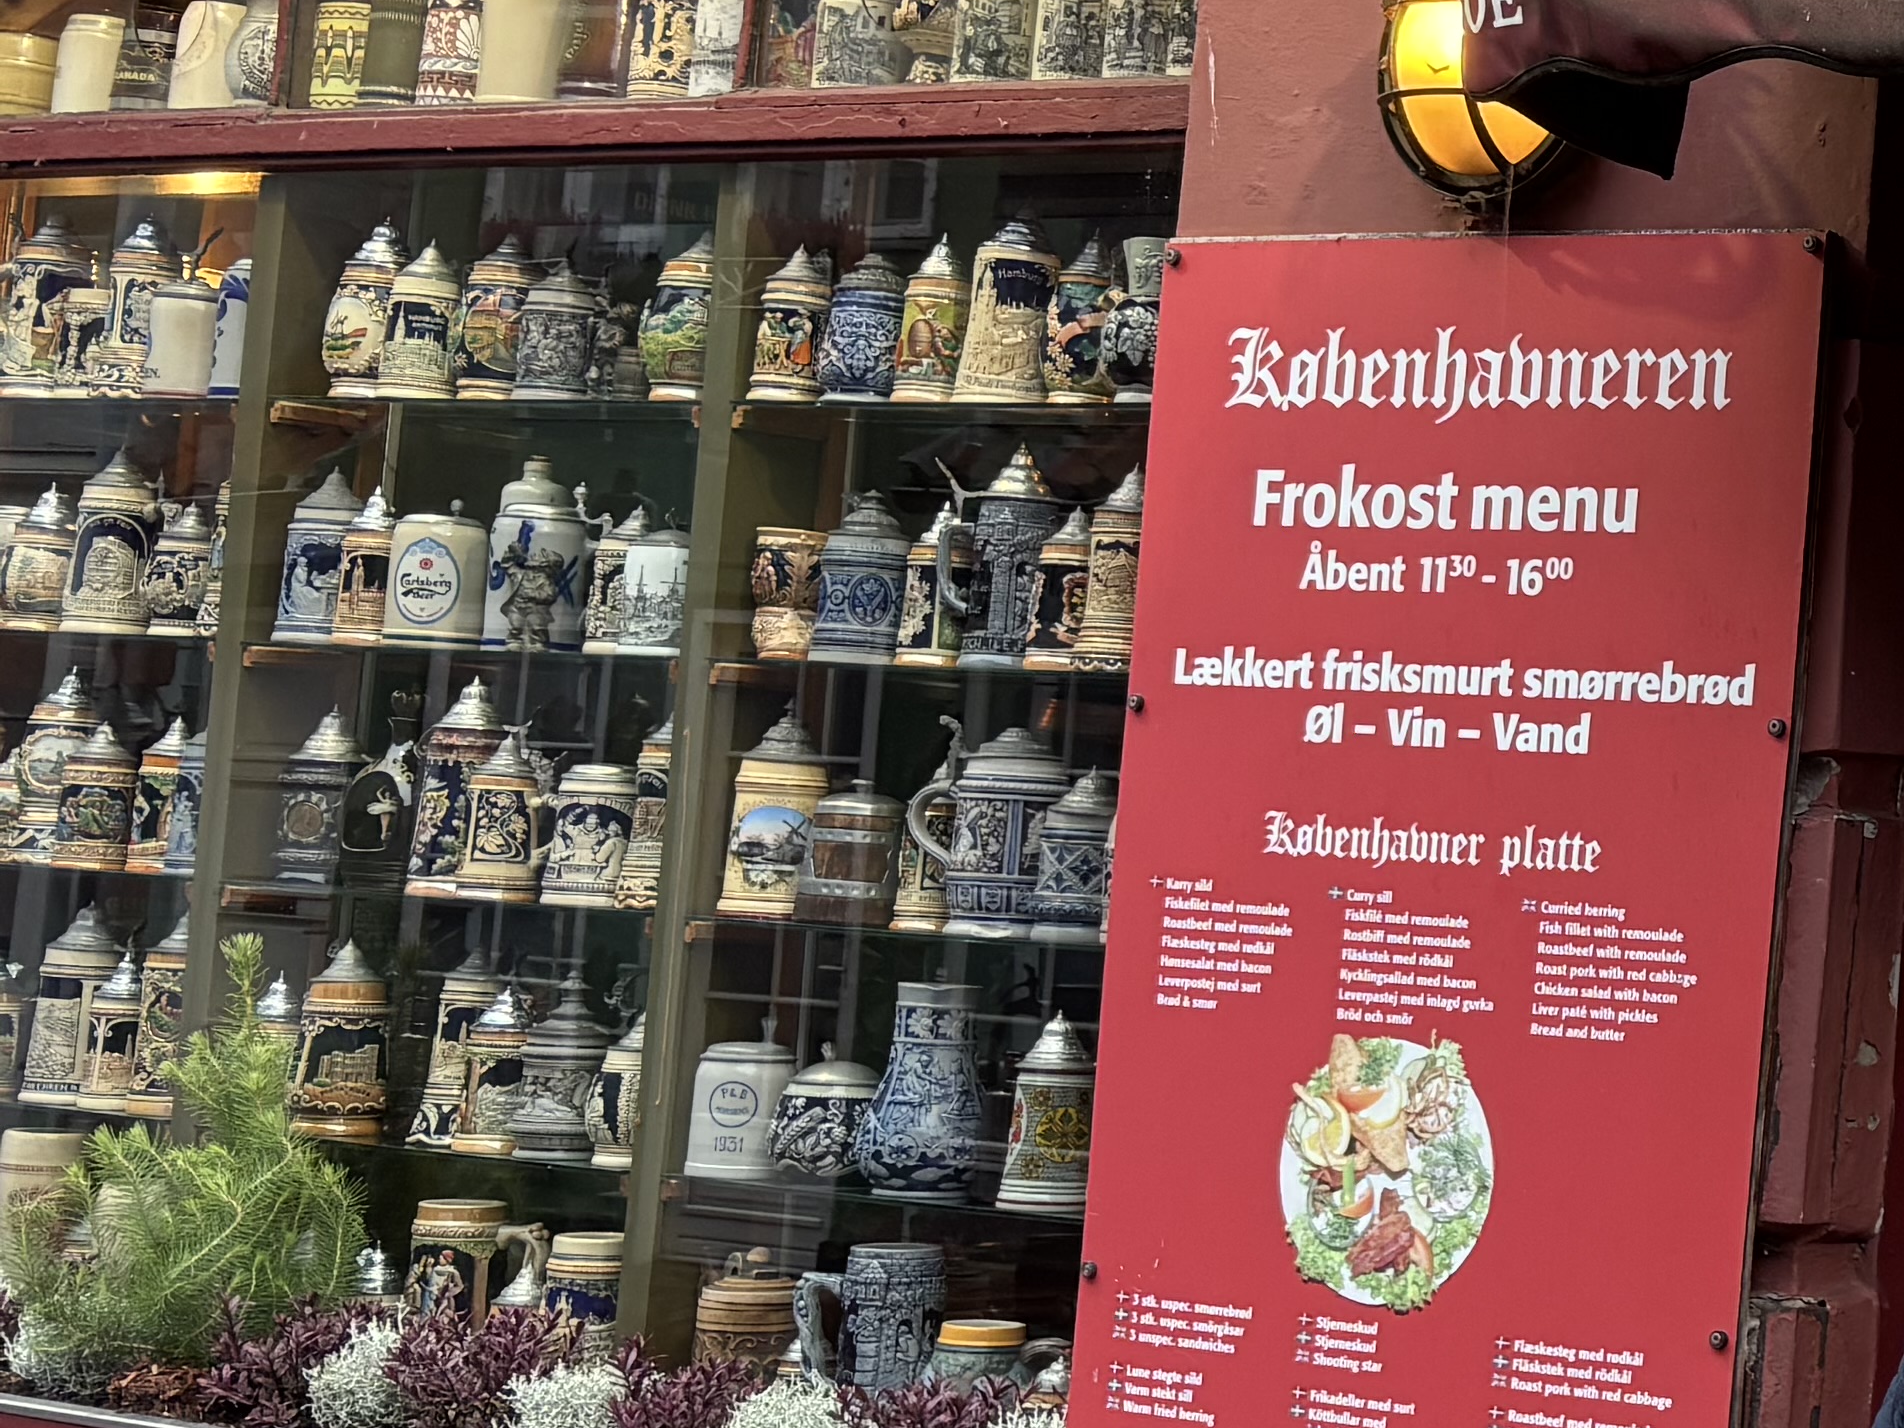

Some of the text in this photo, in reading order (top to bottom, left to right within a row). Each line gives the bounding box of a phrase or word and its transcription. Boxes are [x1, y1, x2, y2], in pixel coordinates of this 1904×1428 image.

[1224, 325, 1733, 424] Københavneren
[1252, 463, 1639, 534] Frokost menu
[1299, 540, 1405, 593] Åbent
[400, 573, 451, 594] Carlsberg
[412, 590, 436, 600] Beer
[1174, 647, 1756, 707] Lækkert frisksmurt smørrebrød
[1303, 703, 1343, 745] Øl
[1387, 707, 1446, 749] Vin
[1493, 712, 1591, 754] Vand
[1263, 810, 1602, 876] Københavner platte
[1347, 889, 1393, 905] Curry sill
[1385, 911, 1409, 924] med
[1411, 914, 1469, 929] remoulade
[1541, 901, 1626, 921] Curried herring
[1344, 929, 1471, 949] Rostbiff med remoulade
[1539, 921, 1684, 942] Fish fillet with remoulade
[1393, 950, 1416, 965] med
[1538, 942, 1687, 964] Roastbeef with remoulade
[1417, 973, 1440, 987] med
[1443, 975, 1477, 989] bacon
[1536, 962, 1567, 976] Roast
[1570, 964, 1596, 980] pork
[1599, 966, 1624, 980] with
[1627, 969, 1646, 981] red
[1159, 974, 1215, 992] Leverpostej
[1217, 979, 1239, 991] med
[1534, 982, 1678, 1004] Chicken salad with bacon
[1338, 988, 1398, 1006] Leverpastej
[1401, 994, 1424, 1006] med
[1337, 1008, 1414, 1025] Bröd och smör
[1532, 1003, 1658, 1024] Liver paté with pickles
[1530, 1023, 1625, 1041] Bread and butter
[714, 1136, 744, 1152] 1931
[1313, 1353, 1383, 1373] Shooting star
